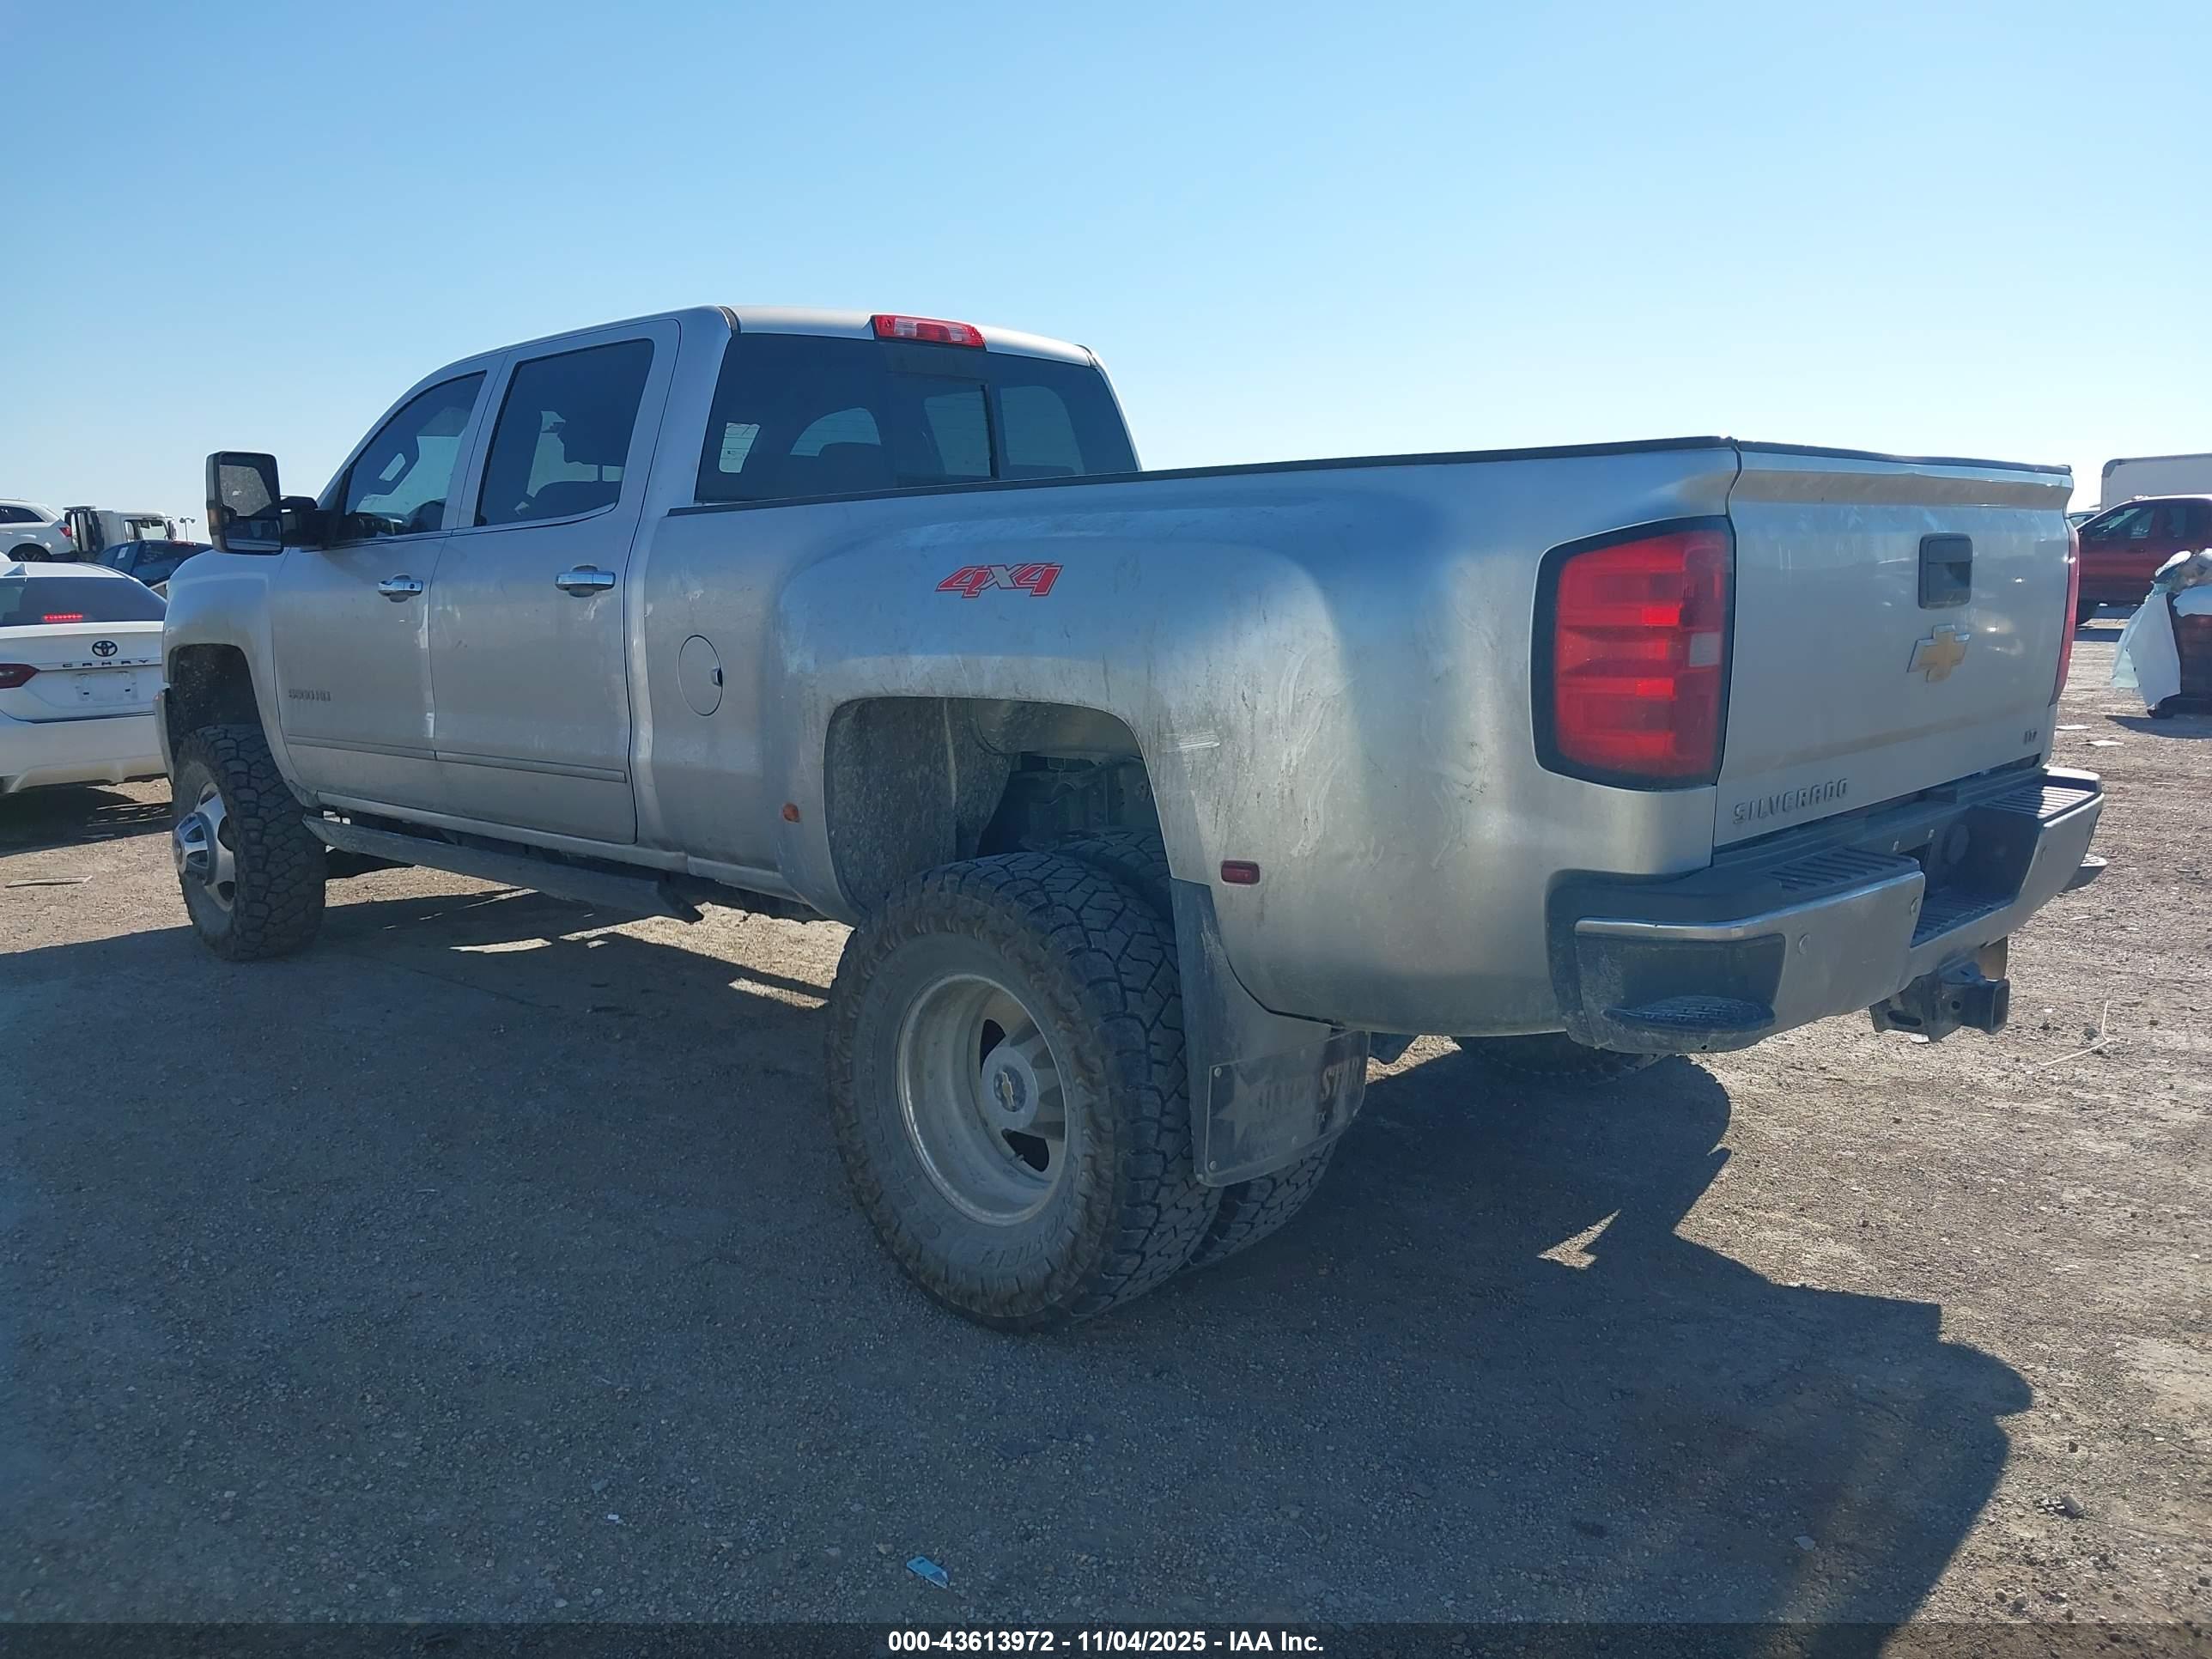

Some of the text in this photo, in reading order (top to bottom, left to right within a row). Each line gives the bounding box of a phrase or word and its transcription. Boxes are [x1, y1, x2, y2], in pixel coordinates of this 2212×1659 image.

[934, 562, 1064, 599] 4X4
[63, 659, 149, 668] CAMRY
[1732, 777, 1848, 825] SILVERADO
